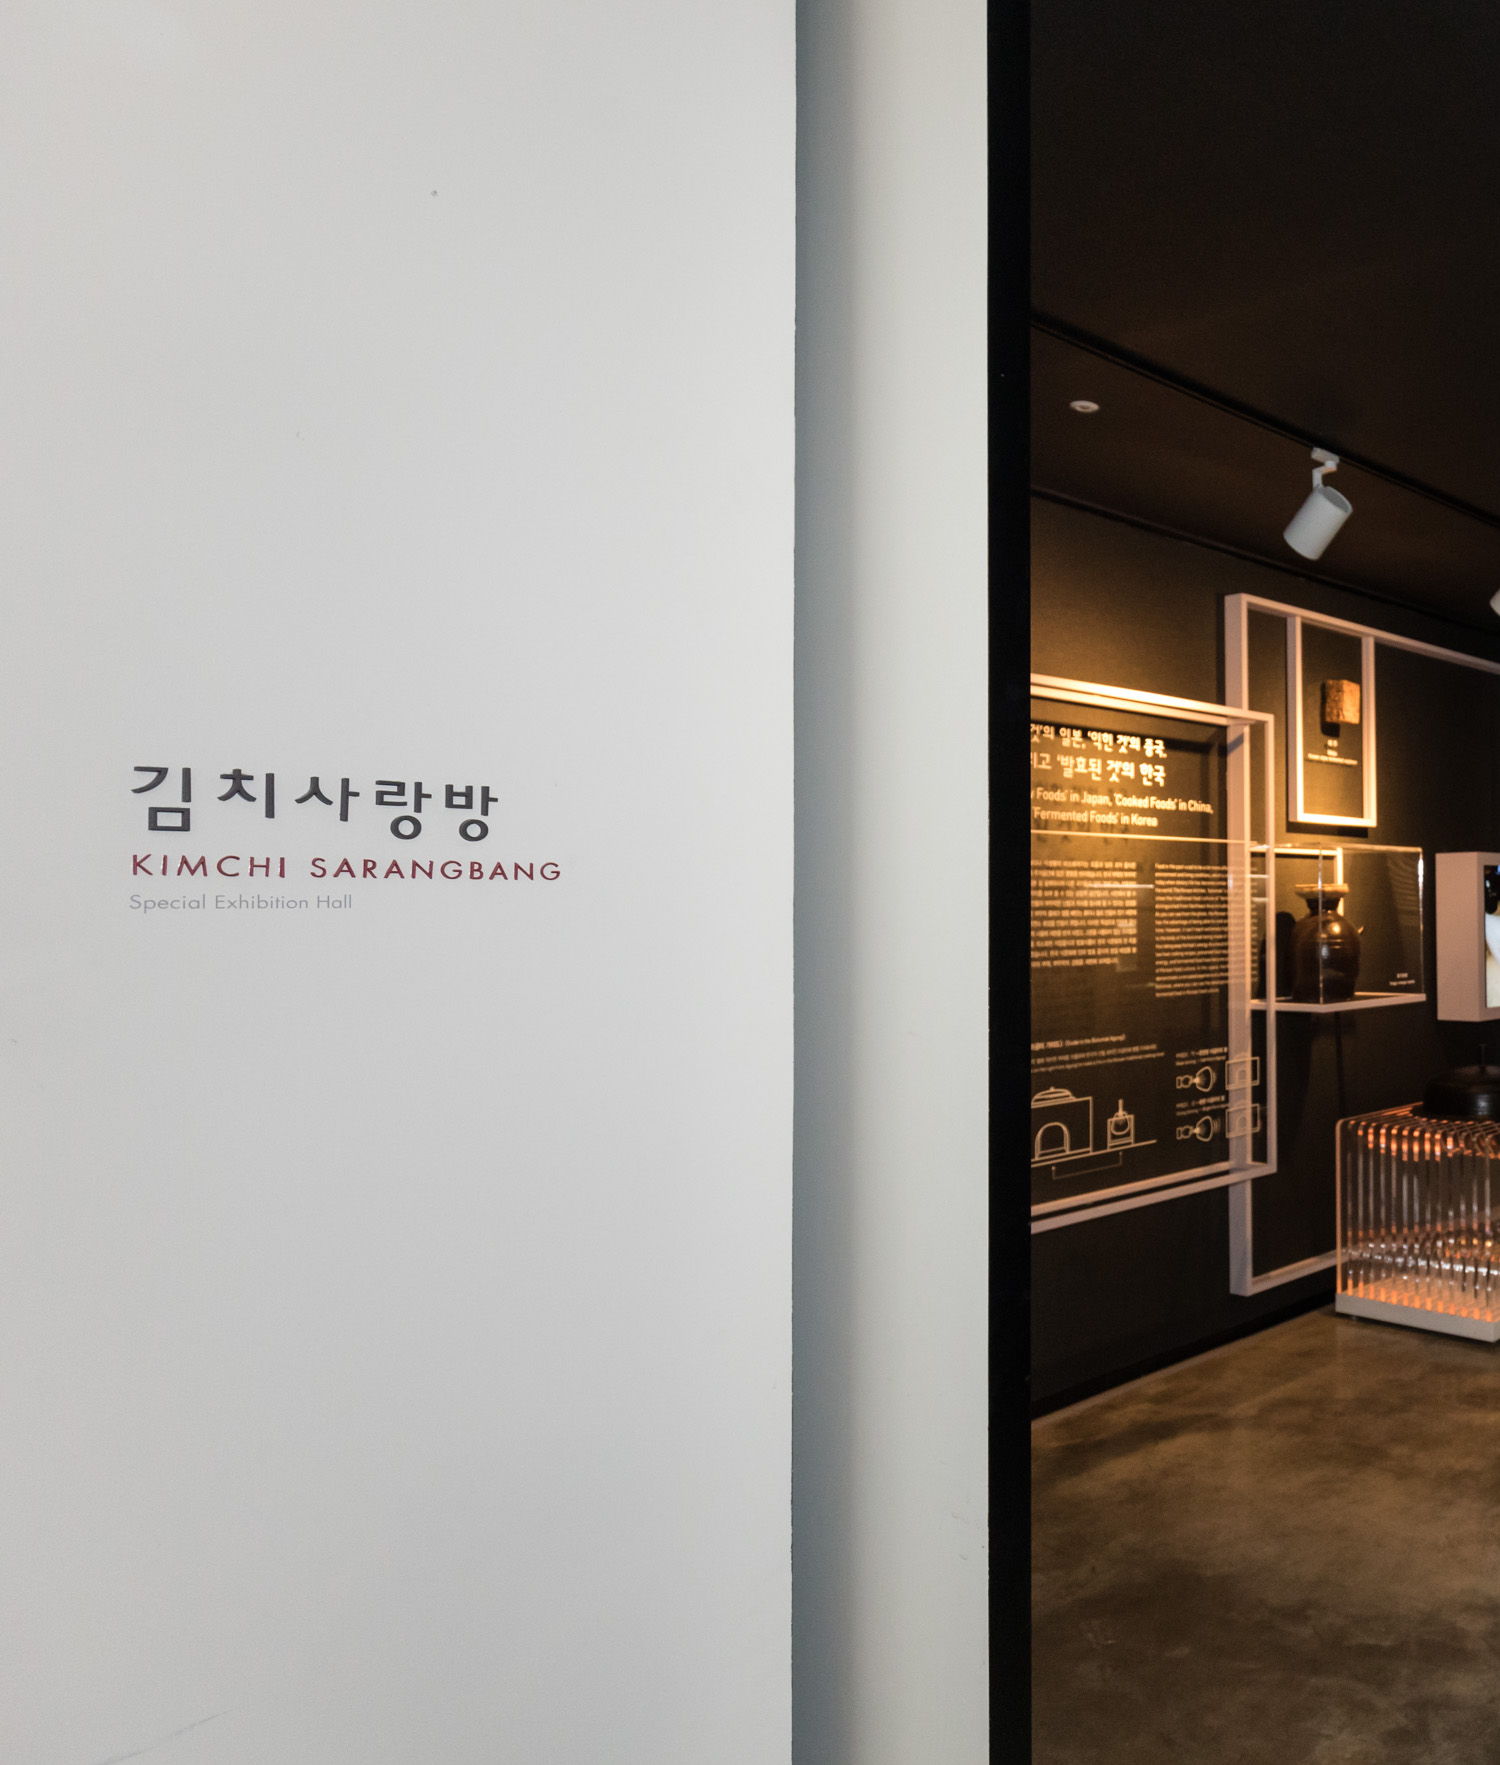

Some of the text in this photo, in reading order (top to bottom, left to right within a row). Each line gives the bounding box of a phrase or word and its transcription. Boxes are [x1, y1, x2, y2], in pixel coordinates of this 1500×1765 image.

[1059, 727, 1086, 750] 일본,
[1106, 760, 1135, 783] 것'의
[1139, 763, 1166, 788] 한국
[131, 766, 499, 842] 김치사랑방
[1069, 790, 1080, 802] in
[1081, 791, 1113, 807] Japan,
[1178, 799, 1188, 811] in
[1188, 800, 1214, 815] China,
[1120, 812, 1130, 825] in
[1131, 813, 1158, 828] Korea
[132, 853, 563, 881] KIMCHI SARANGBANG
[129, 894, 353, 914] Special Exhibition Hall
